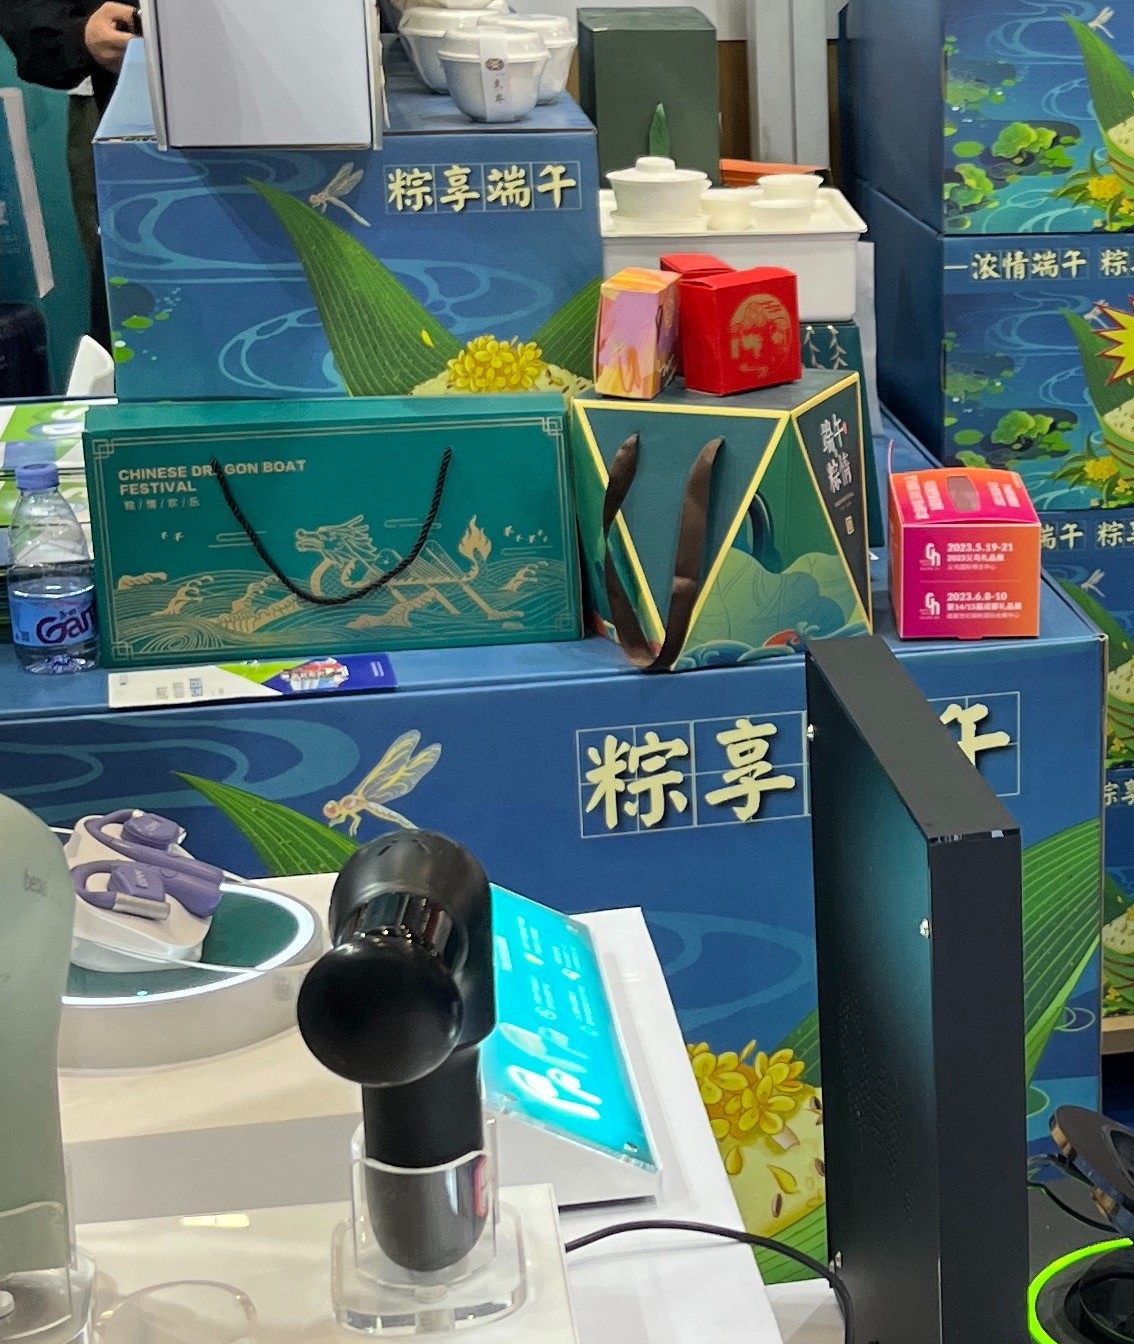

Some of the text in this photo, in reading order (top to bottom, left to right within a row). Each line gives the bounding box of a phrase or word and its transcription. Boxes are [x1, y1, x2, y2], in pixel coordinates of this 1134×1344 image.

[388, 164, 577, 213] 粽享端午
[971, 249, 1087, 280] 浓情端午
[118, 465, 187, 481] CHINESE
[263, 459, 306, 473] BOAT
[119, 481, 197, 495] FESTIVAL
[946, 542, 1014, 552] 2023.5.19-21
[946, 591, 1008, 602] 2023.6.8-10
